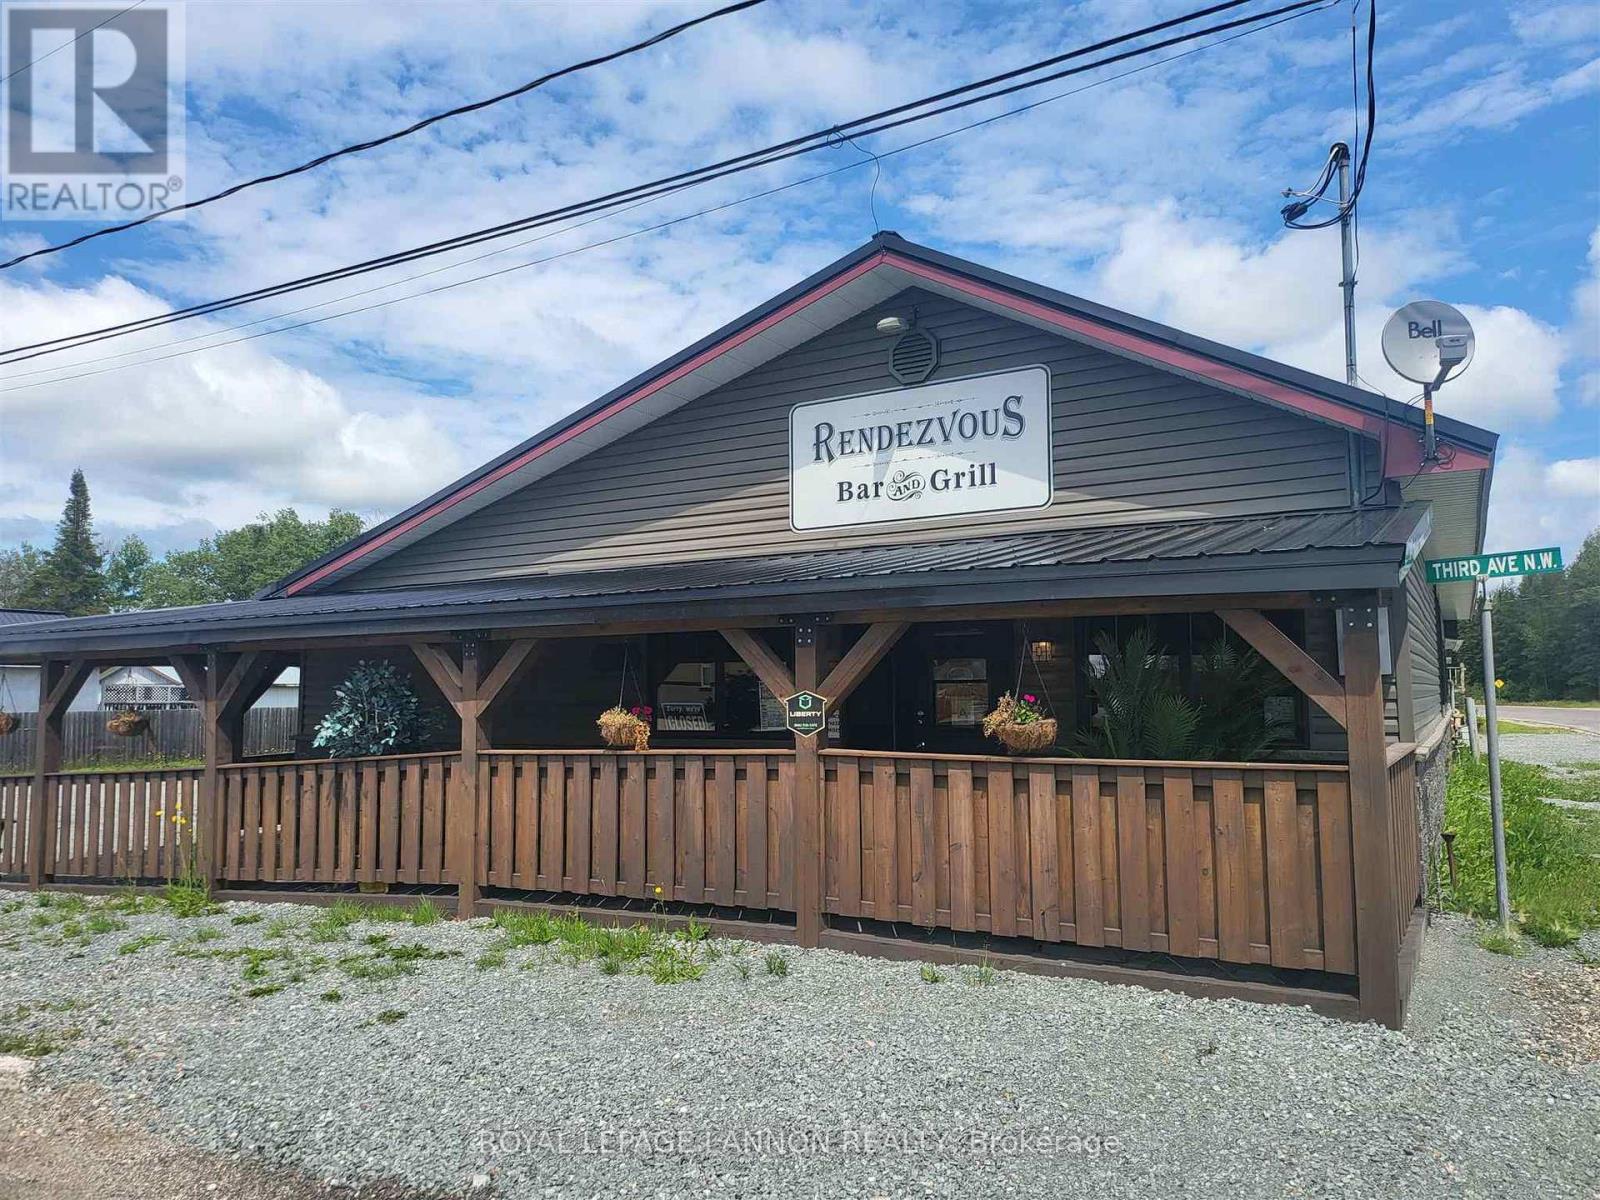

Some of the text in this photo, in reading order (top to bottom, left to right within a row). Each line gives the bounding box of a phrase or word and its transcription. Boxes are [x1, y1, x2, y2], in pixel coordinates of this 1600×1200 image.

[1408, 319, 1442, 339] Bell
[813, 394, 1025, 465] RENDEZVOUS
[837, 462, 998, 501] Bar AND Grill
[1431, 551, 1557, 579] THIRD AVE N.W.
[667, 715, 706, 730] CLOSED
